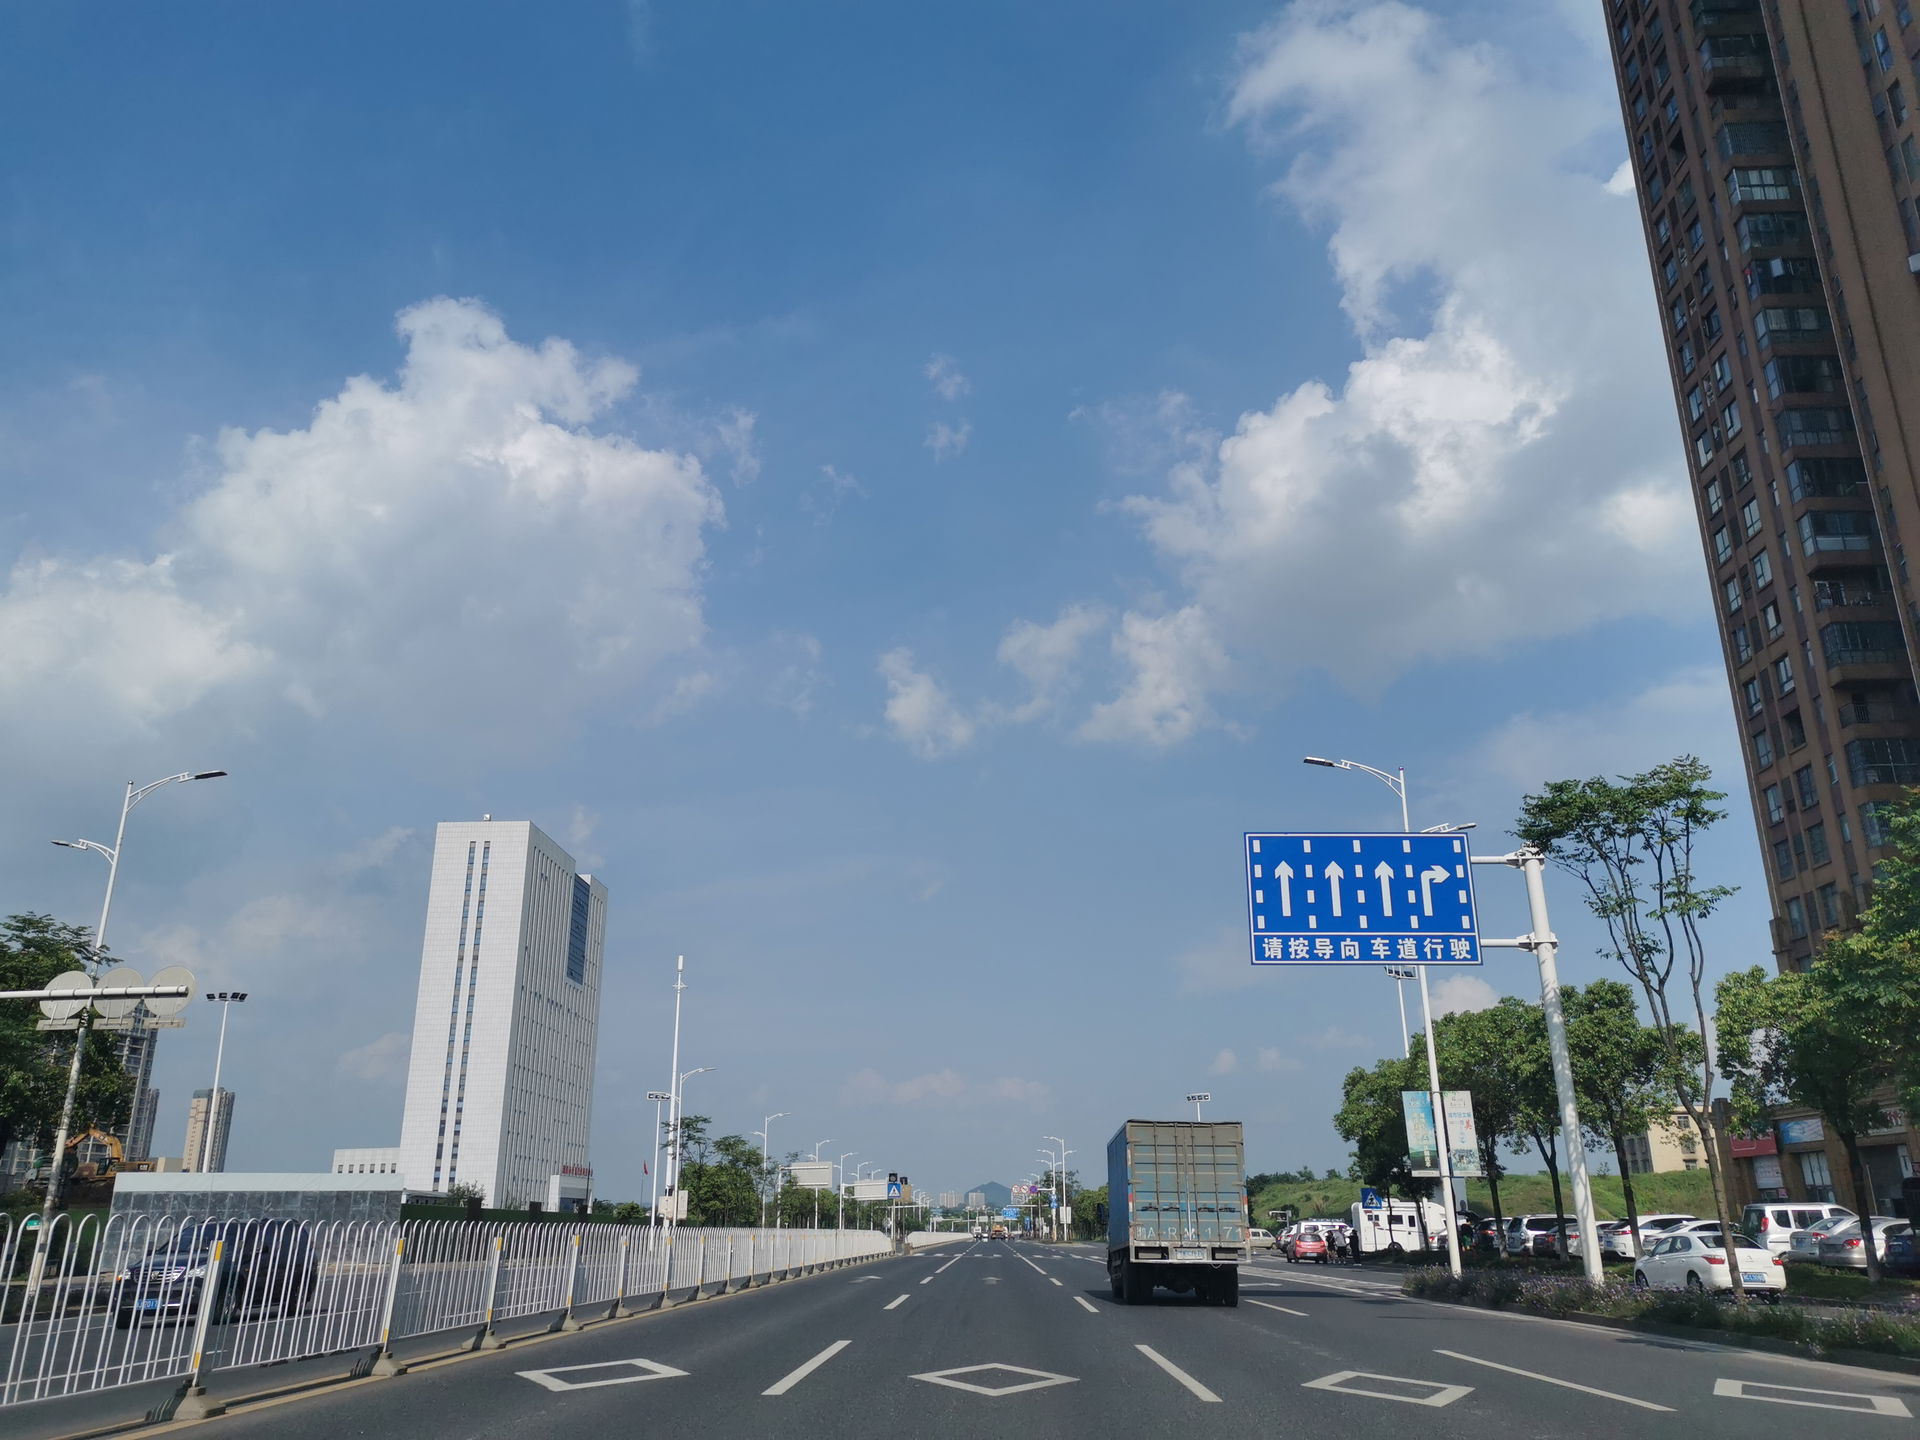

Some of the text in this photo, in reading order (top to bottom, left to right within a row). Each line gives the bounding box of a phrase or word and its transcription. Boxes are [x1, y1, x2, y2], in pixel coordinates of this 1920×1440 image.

[1262, 937, 1472, 960] 请按导向车道行驶
